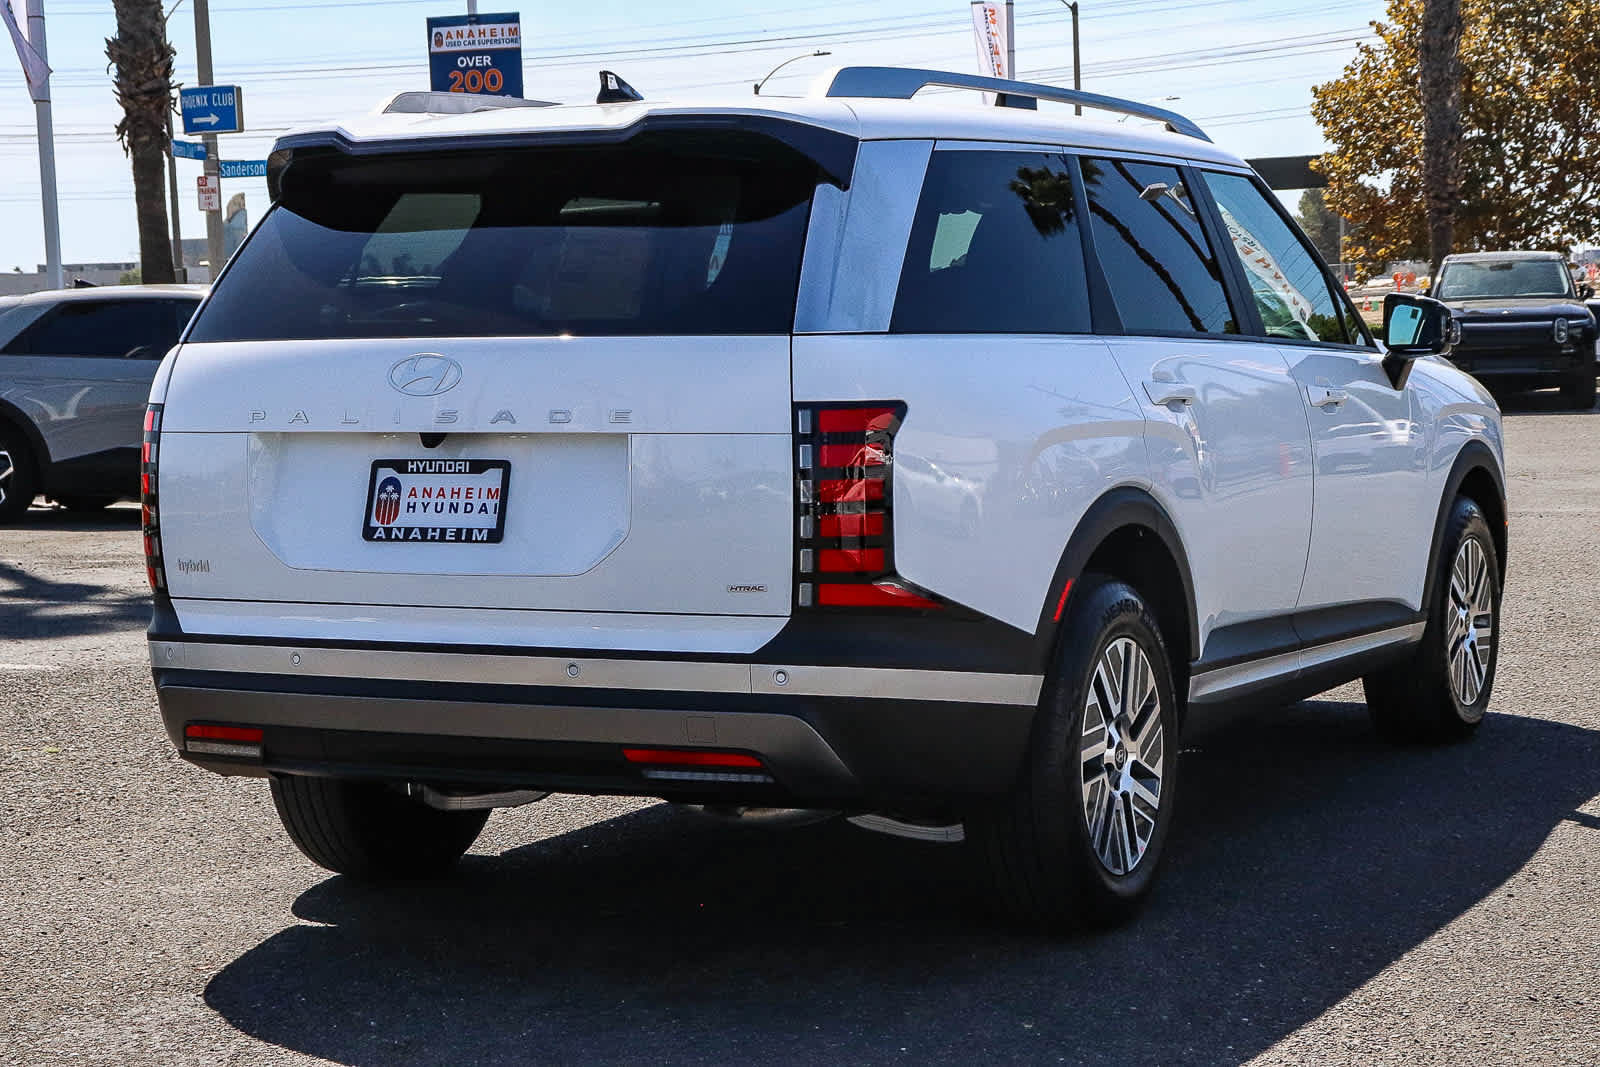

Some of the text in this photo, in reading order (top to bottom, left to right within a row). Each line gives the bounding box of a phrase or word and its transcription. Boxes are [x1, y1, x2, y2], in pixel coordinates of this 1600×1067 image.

[445, 27, 518, 40] ANAHEIM
[478, 38, 519, 46] SUPERSTORE
[457, 55, 492, 67] OVER
[448, 68, 503, 93] 200
[182, 92, 234, 109] PHOENIX CLUB
[221, 162, 265, 177] Sanderson
[248, 409, 633, 425] PALISADE
[407, 460, 470, 473] HYUNDAI
[407, 486, 500, 500] ANAHEIM
[406, 502, 499, 514] HYUNDAI
[373, 527, 489, 541] ANAHEIM
[178, 557, 210, 575] hybrid
